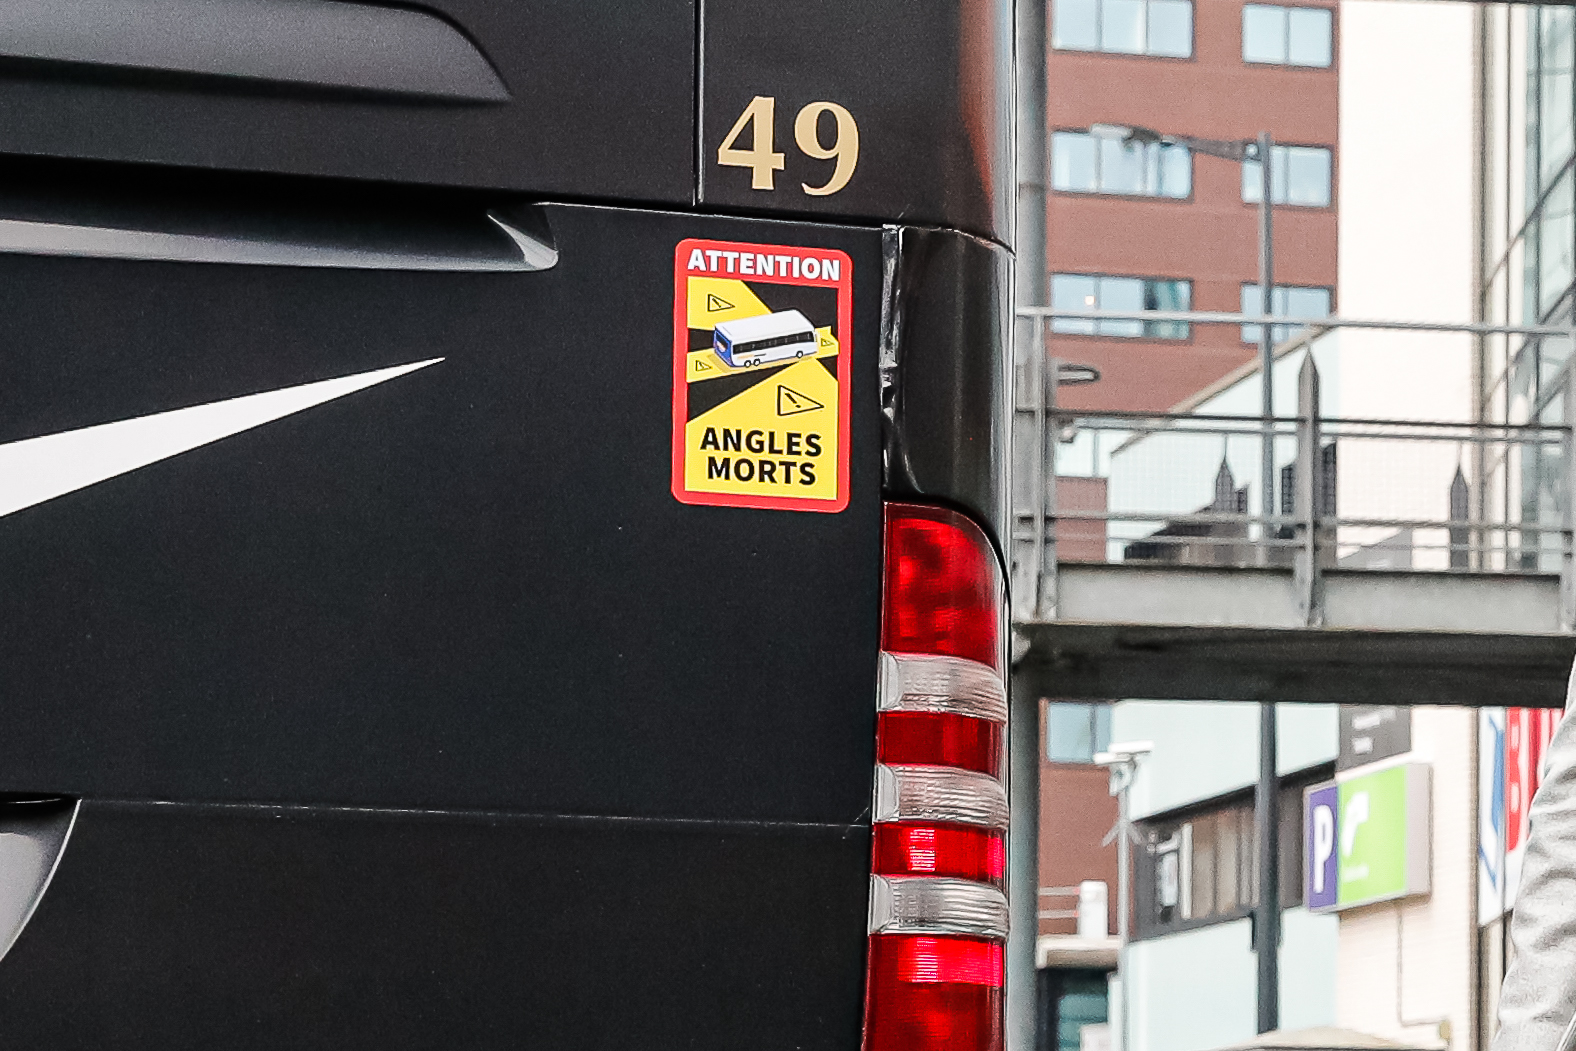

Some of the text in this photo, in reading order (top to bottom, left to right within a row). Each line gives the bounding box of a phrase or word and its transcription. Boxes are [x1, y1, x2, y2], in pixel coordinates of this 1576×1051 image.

[717, 96, 860, 197] 49
[687, 248, 841, 282] ATTENTION
[700, 426, 822, 457] ANGLES
[707, 458, 816, 485] MORTS
[1312, 804, 1334, 894] P
